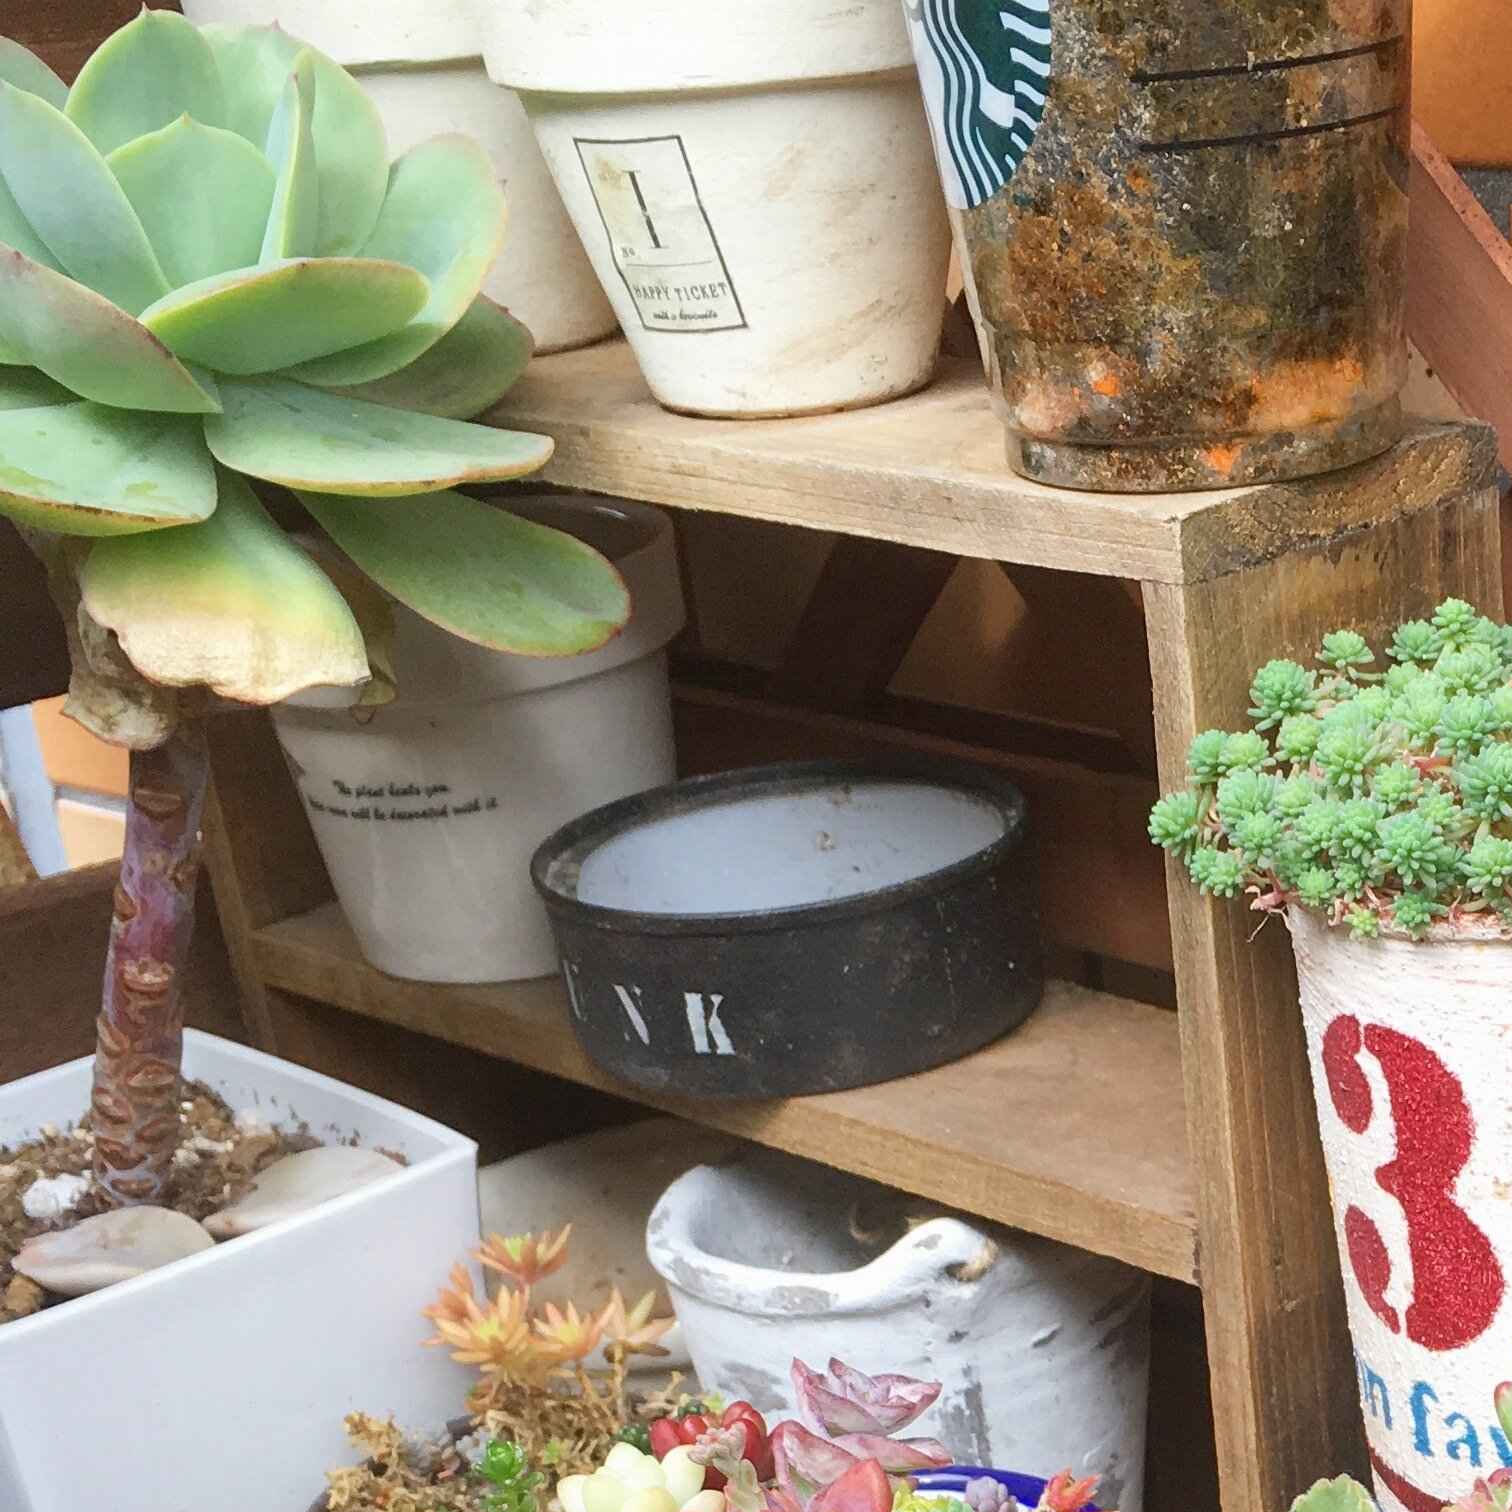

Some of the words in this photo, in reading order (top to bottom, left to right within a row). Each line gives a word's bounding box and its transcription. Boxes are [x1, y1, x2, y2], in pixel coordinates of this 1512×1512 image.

[633, 283, 670, 301] HAPPY
[674, 281, 728, 302] TICKET
[1322, 1013, 1505, 1352] 3
